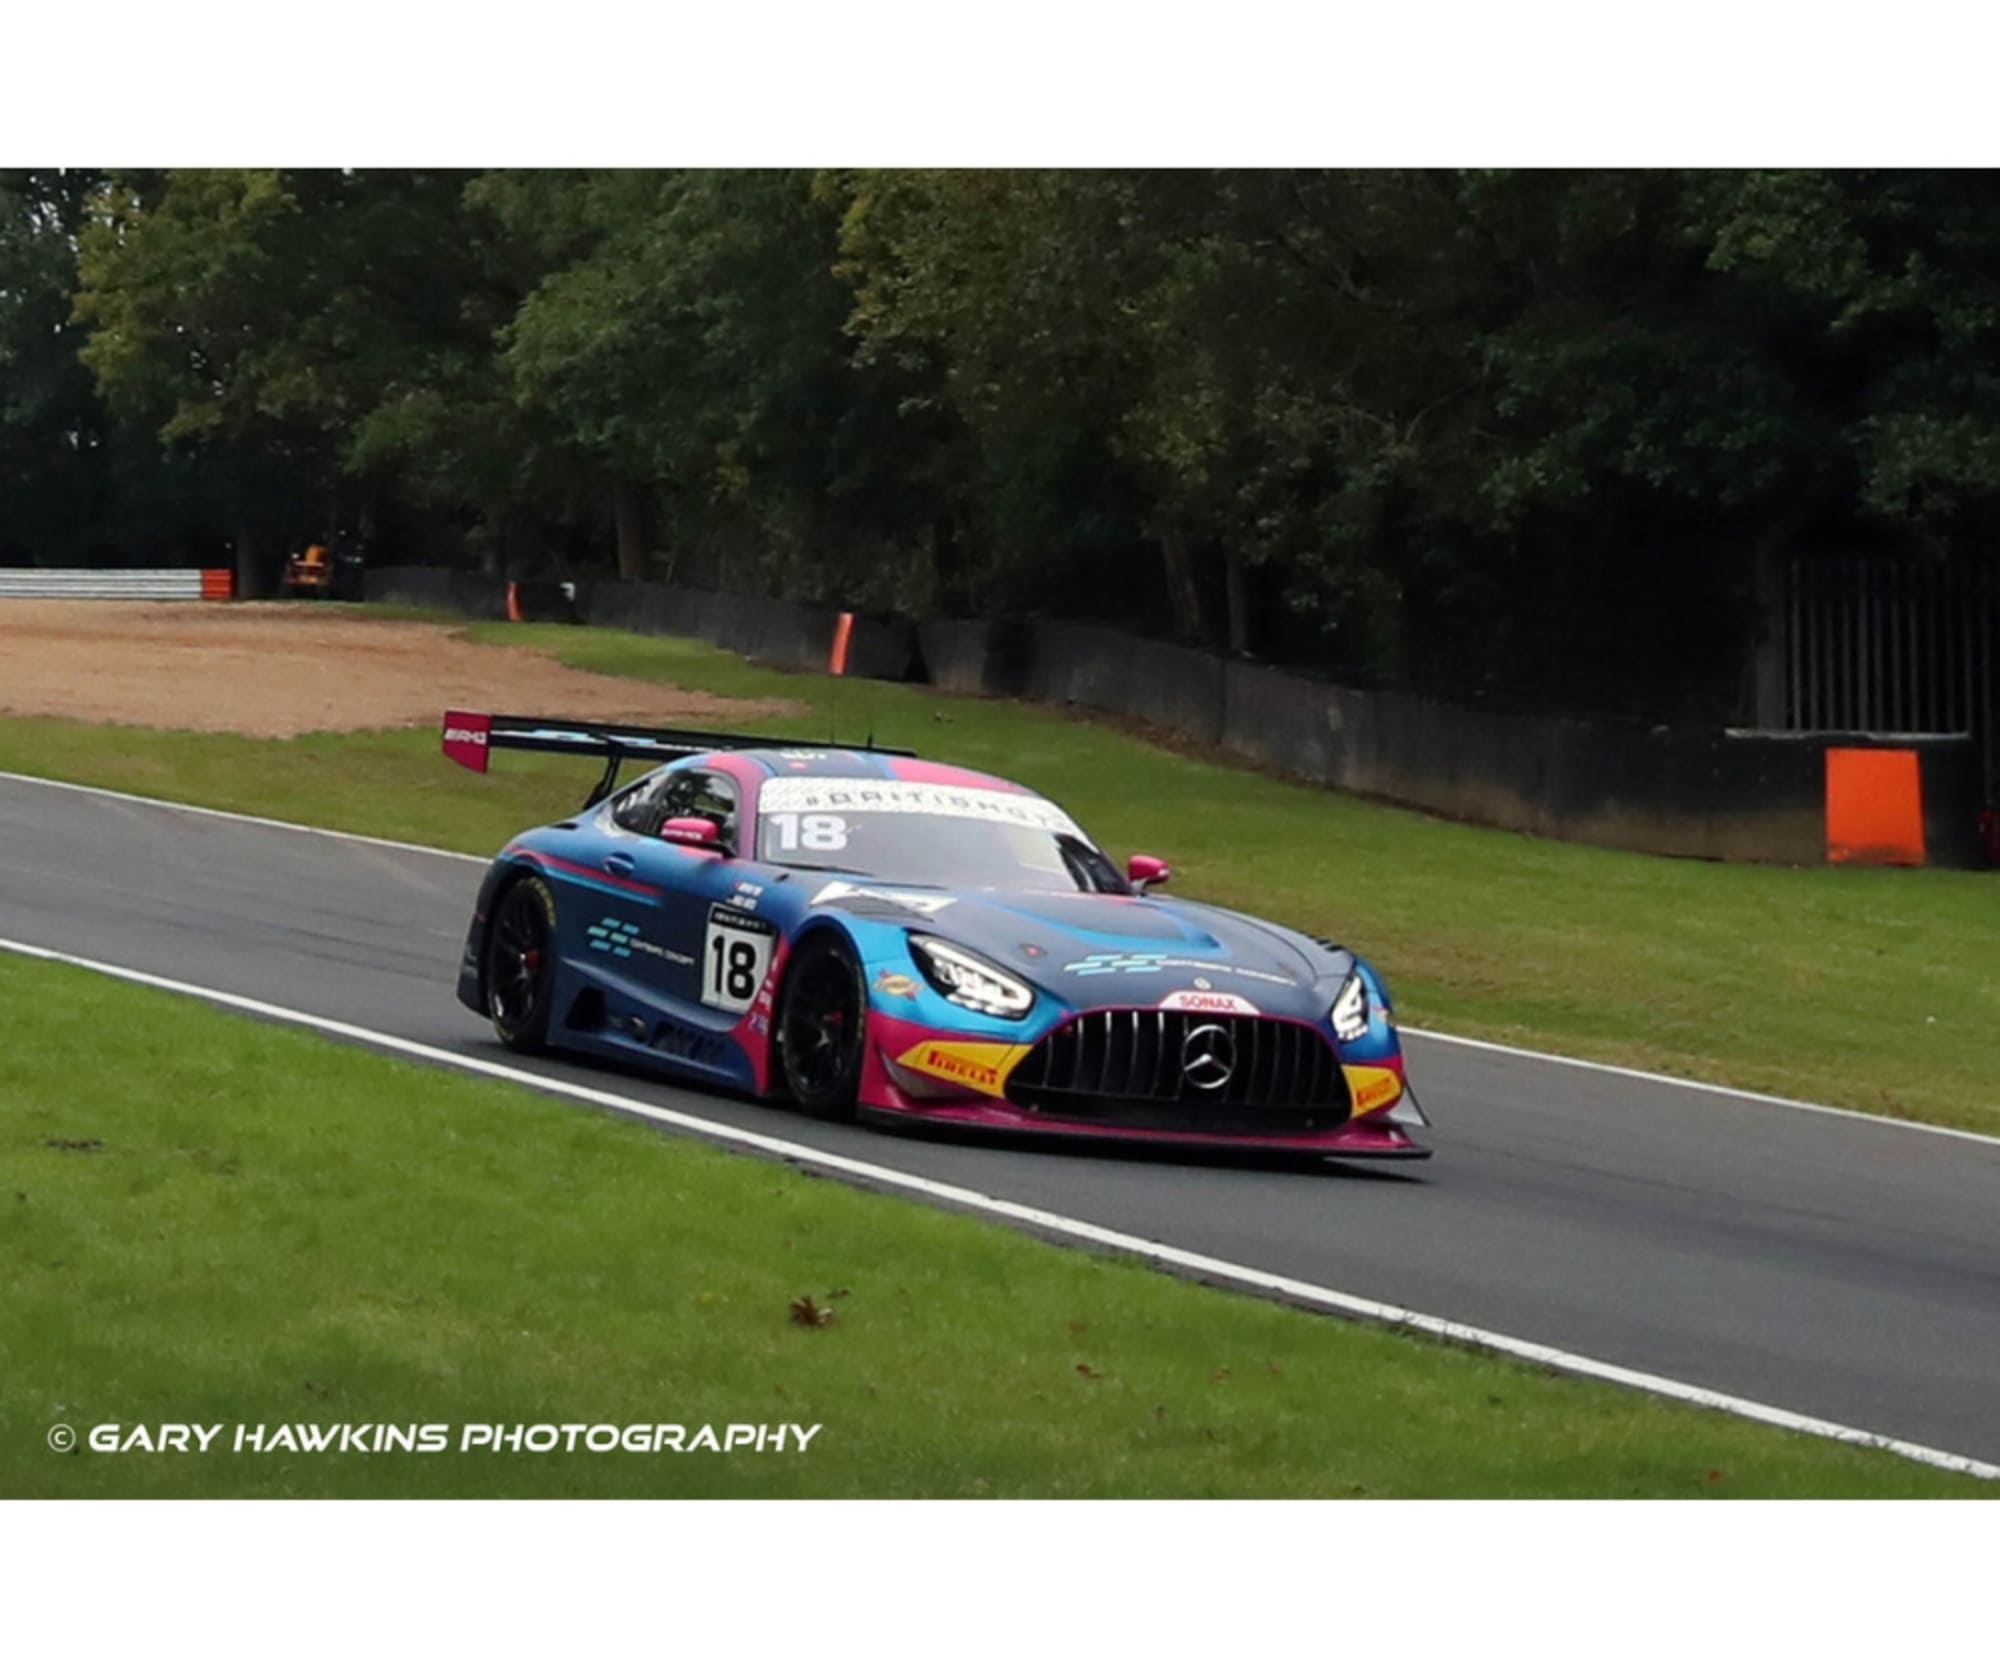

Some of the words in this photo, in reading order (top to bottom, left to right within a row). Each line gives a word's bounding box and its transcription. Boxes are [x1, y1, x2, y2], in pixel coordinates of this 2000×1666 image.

[768, 813, 848, 851] 18
[712, 934, 757, 999] 18
[1179, 994, 1236, 1010] SONAX
